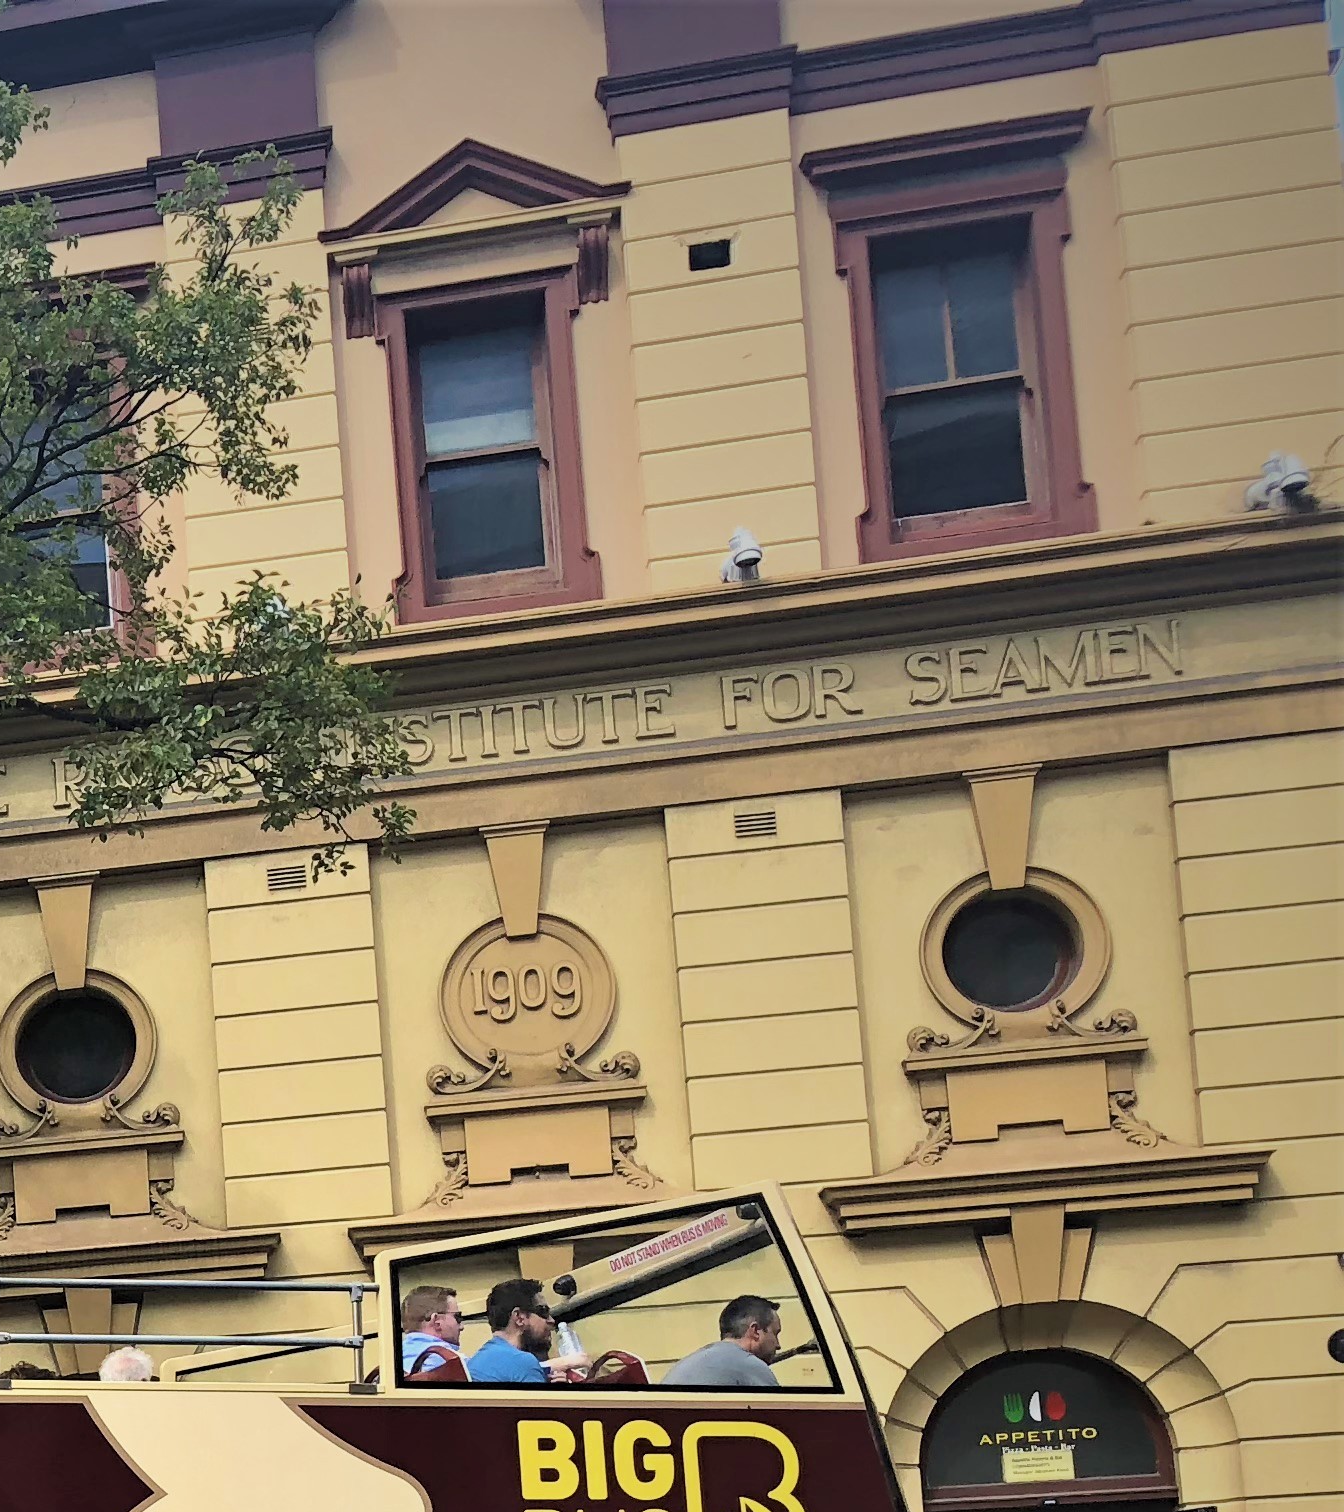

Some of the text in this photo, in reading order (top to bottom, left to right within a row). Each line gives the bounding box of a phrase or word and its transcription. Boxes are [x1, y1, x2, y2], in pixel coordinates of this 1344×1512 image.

[324, 682, 676, 778] STITUTE
[721, 662, 862, 730] FOR
[906, 619, 1185, 706] SEAMEN
[470, 961, 582, 1023] 1909
[609, 1258, 622, 1272] DO
[622, 1250, 637, 1268] NOT
[636, 1242, 661, 1262] STAND
[659, 1233, 683, 1252] WHEN
[681, 1226, 696, 1243] BUS
[701, 1213, 729, 1233] MOVING
[517, 1419, 676, 1501] BIG
[979, 1427, 1098, 1445] APPETITO
